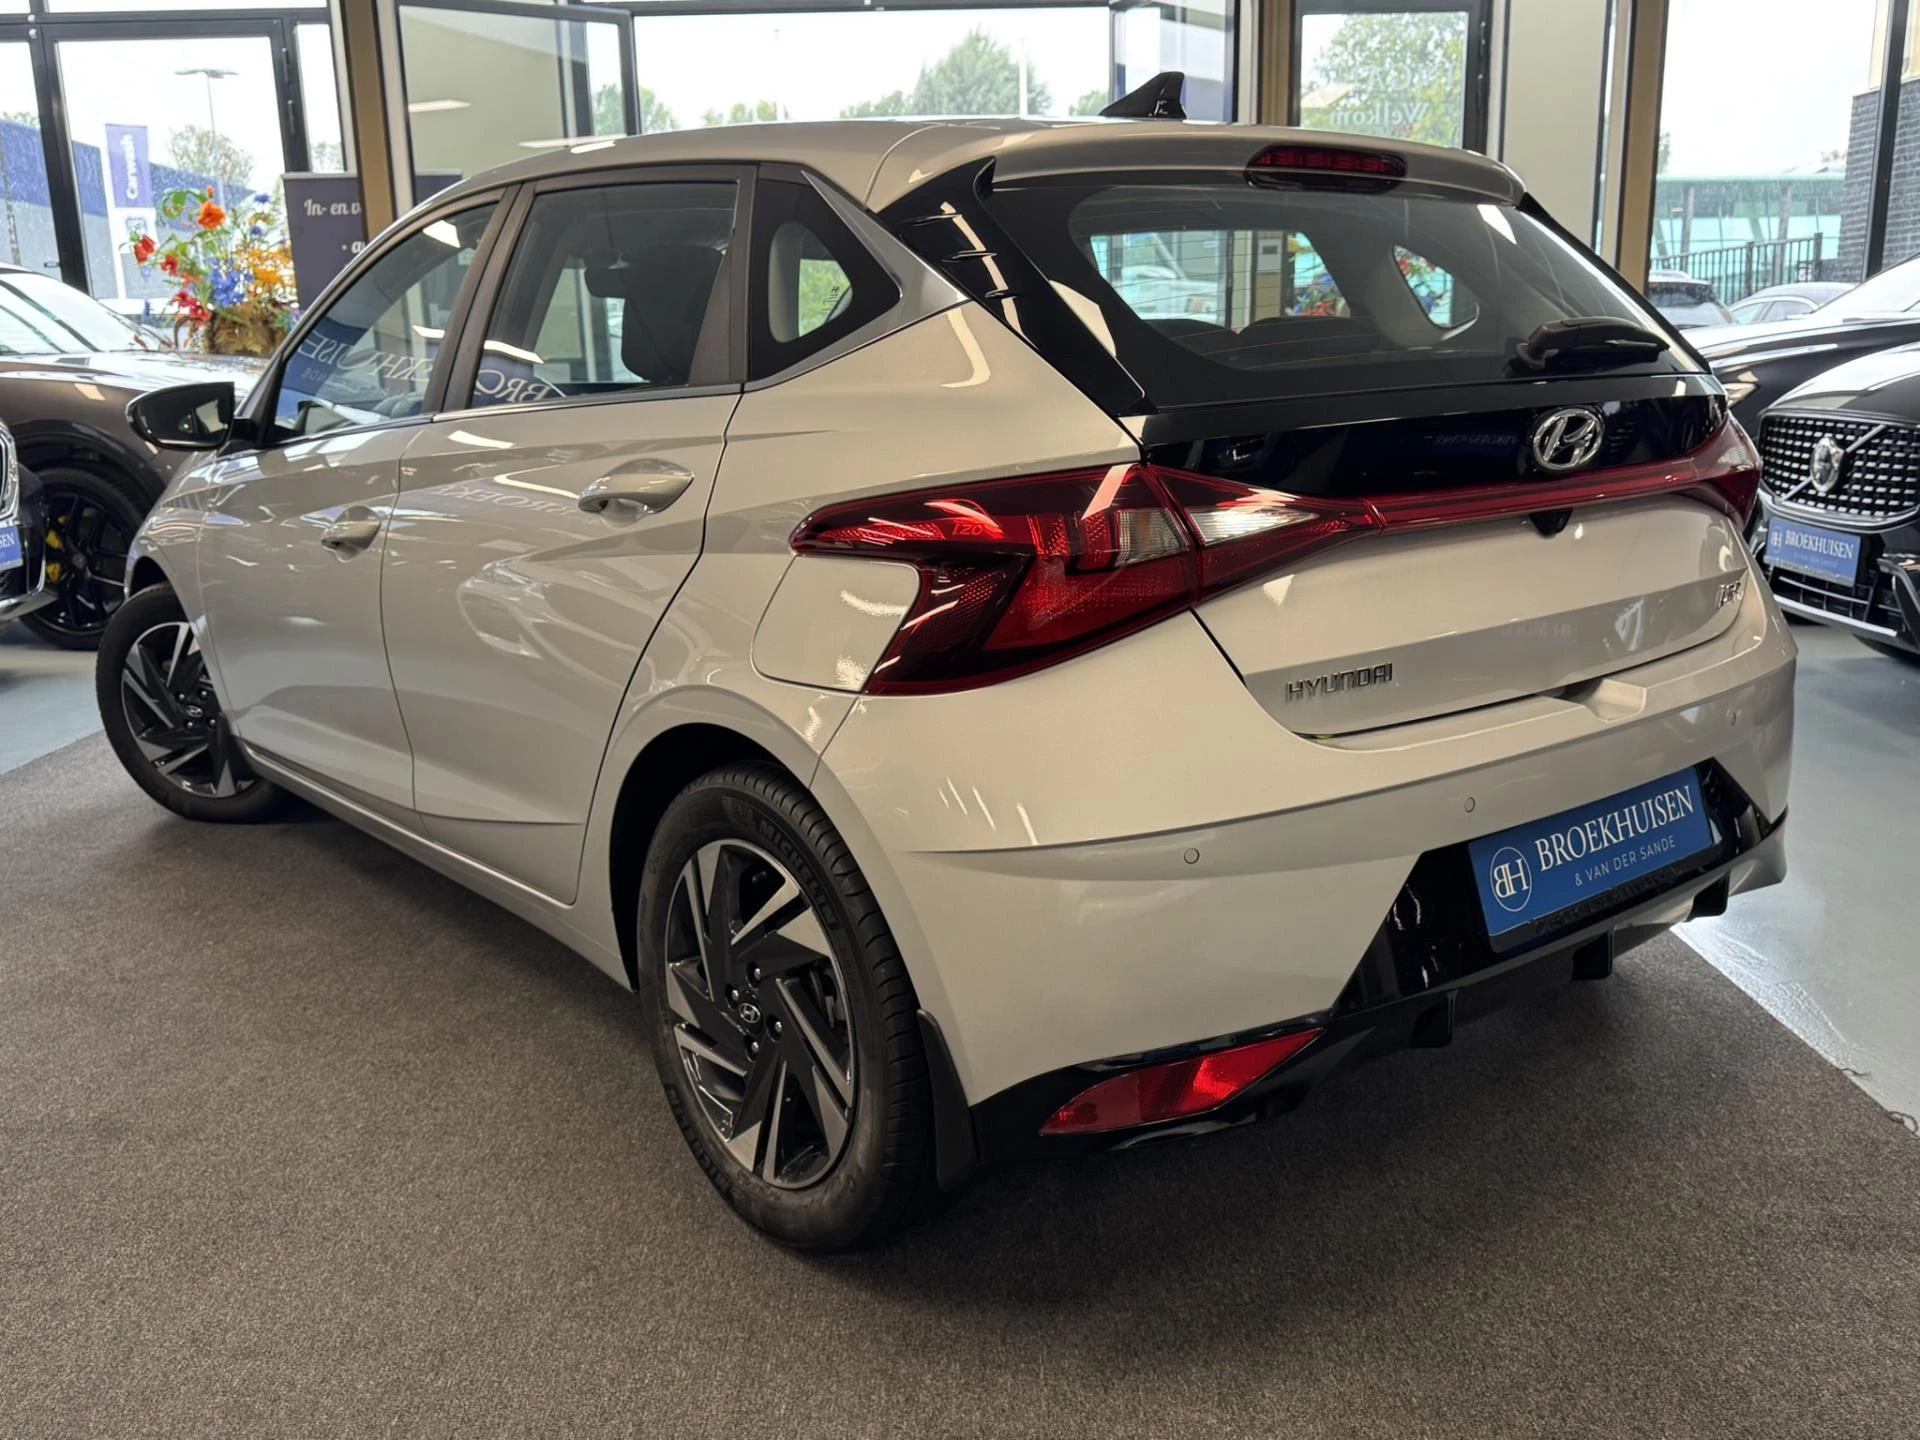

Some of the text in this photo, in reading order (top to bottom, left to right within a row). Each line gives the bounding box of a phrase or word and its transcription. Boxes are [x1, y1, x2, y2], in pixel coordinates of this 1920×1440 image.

[330, 203, 349, 215] en
[1785, 530, 1855, 560] BROEKHUISEN
[1285, 661, 1393, 702] HYUNDAI
[1534, 784, 1695, 872] BROEKHUISEN
[757, 818, 839, 930] MICHELIN
[1574, 834, 1677, 887] & VAN DER SANDE
